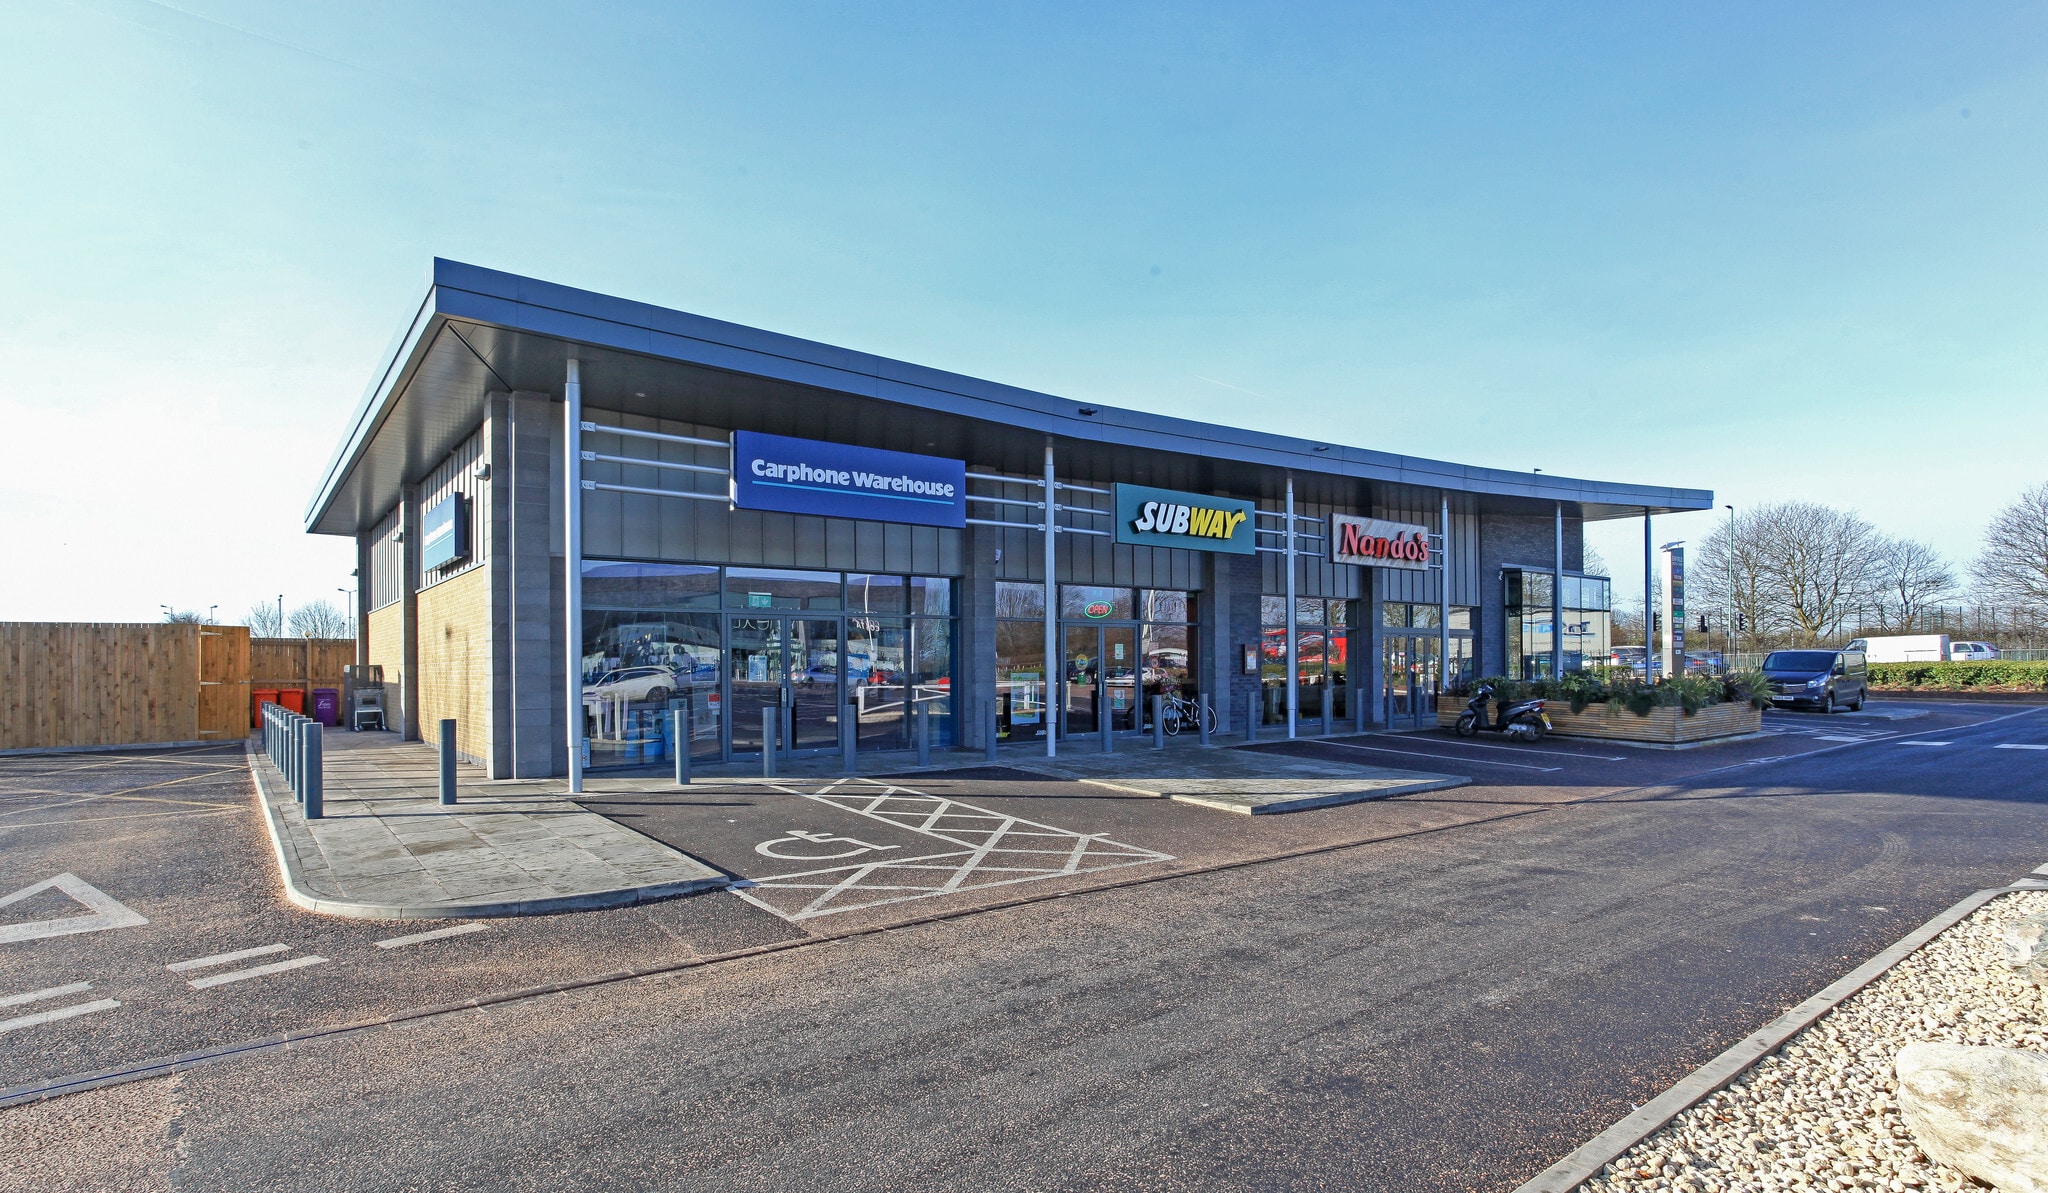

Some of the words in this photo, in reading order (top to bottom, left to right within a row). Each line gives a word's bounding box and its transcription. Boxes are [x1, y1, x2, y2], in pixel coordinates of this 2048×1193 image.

[751, 459, 850, 485] Carphone
[852, 471, 955, 497] Warehouse
[1135, 501, 1247, 539] SUBWAY
[1340, 522, 1429, 561] Nando's
[1087, 603, 1109, 614] OPEN
